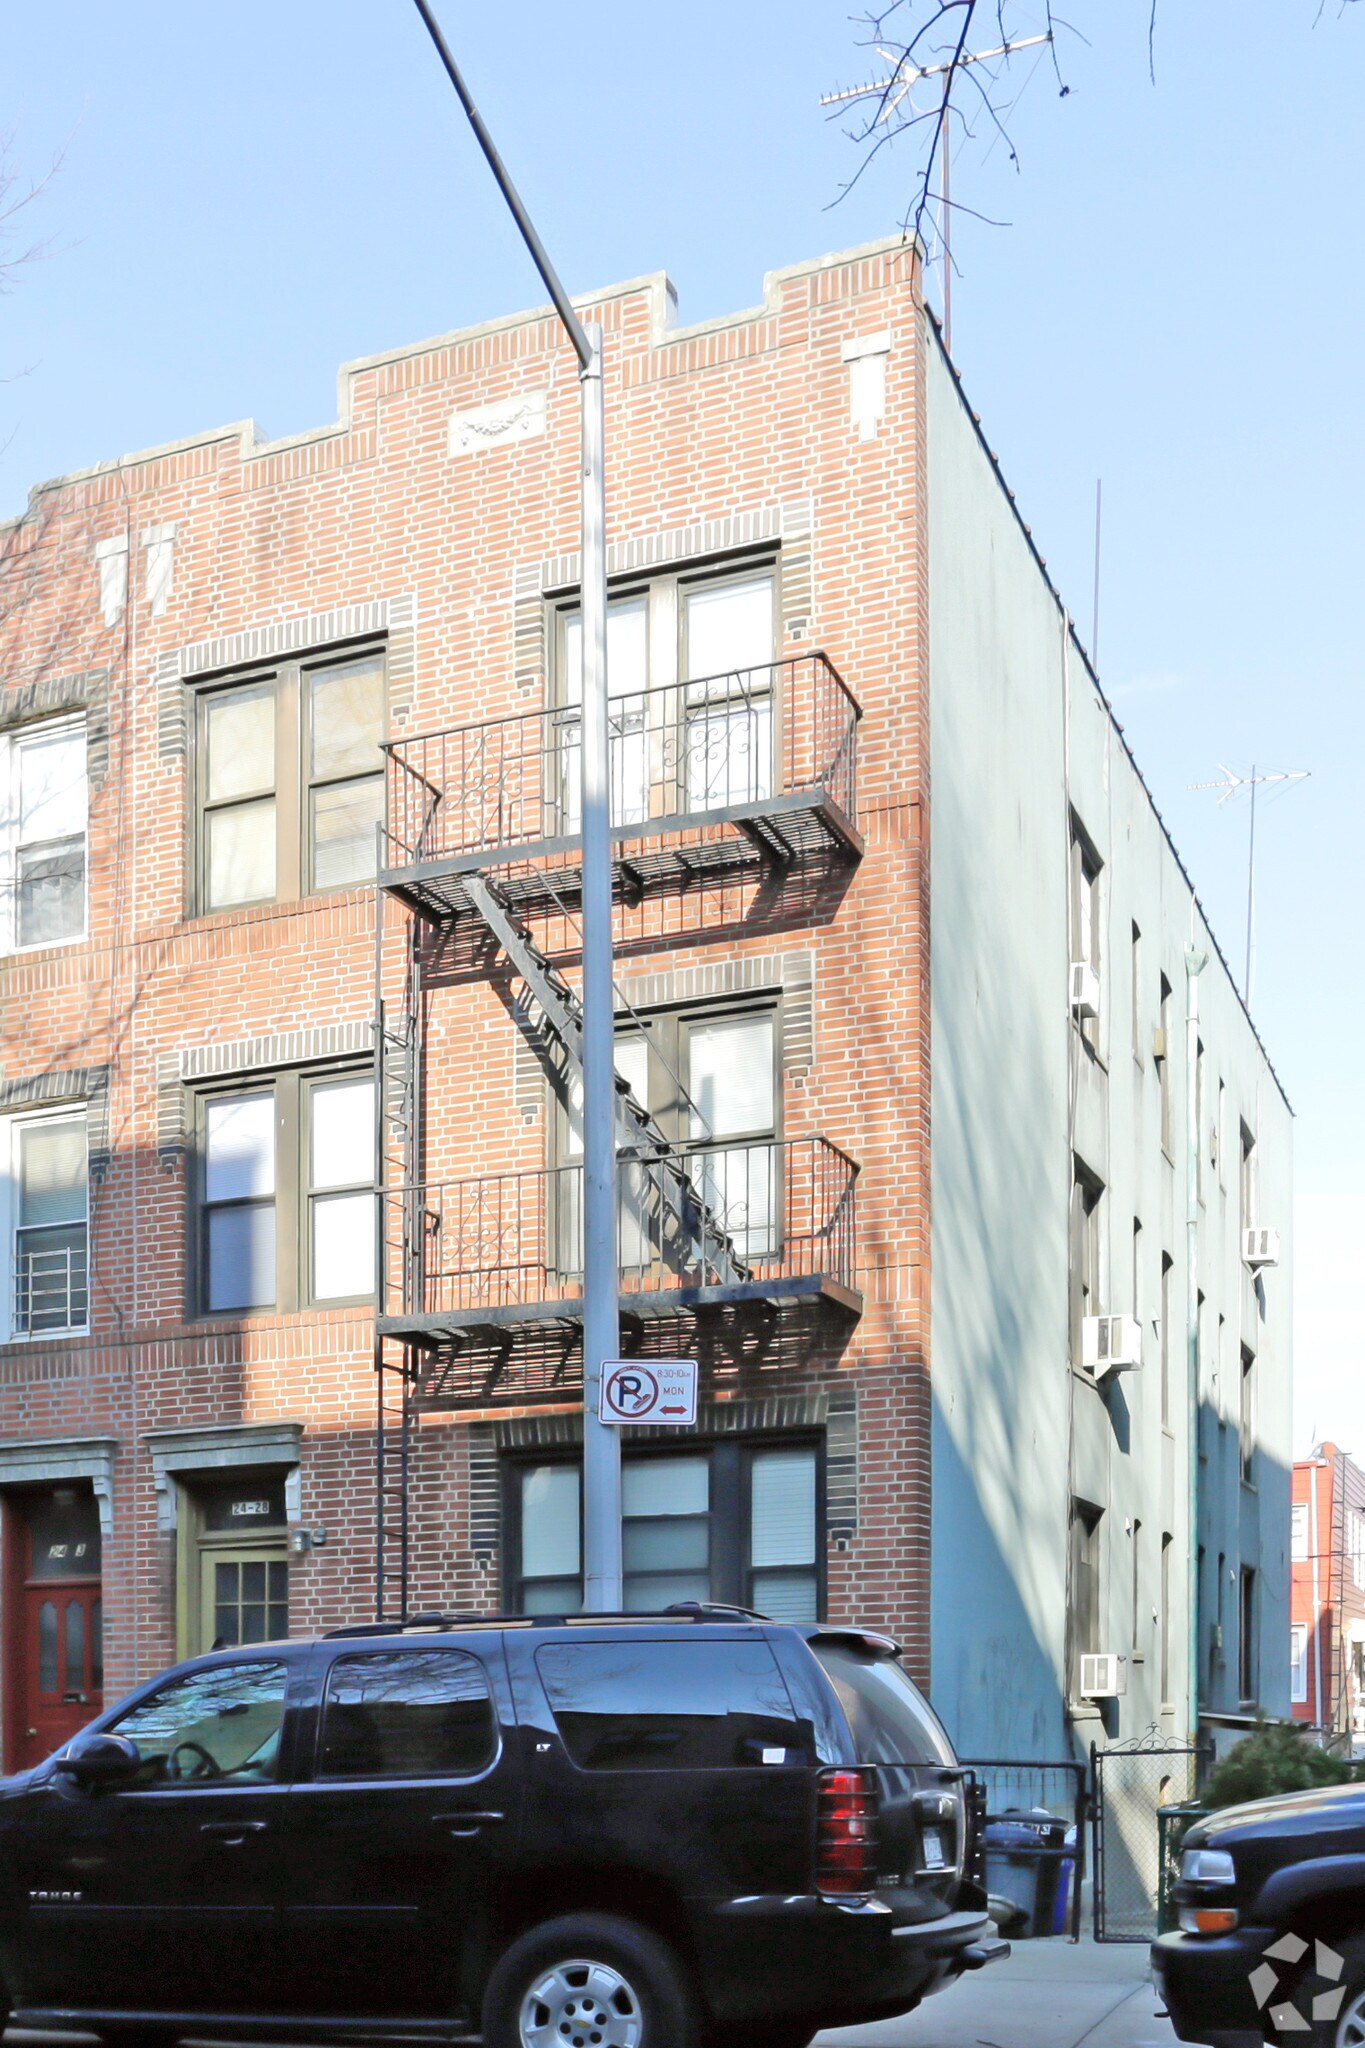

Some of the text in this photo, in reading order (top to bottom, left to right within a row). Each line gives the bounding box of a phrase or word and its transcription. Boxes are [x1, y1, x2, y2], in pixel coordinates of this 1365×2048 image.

[663, 1386, 685, 1396] MON
[233, 1502, 268, 1514] 24-28
[29, 1891, 82, 1900] TAHOE
